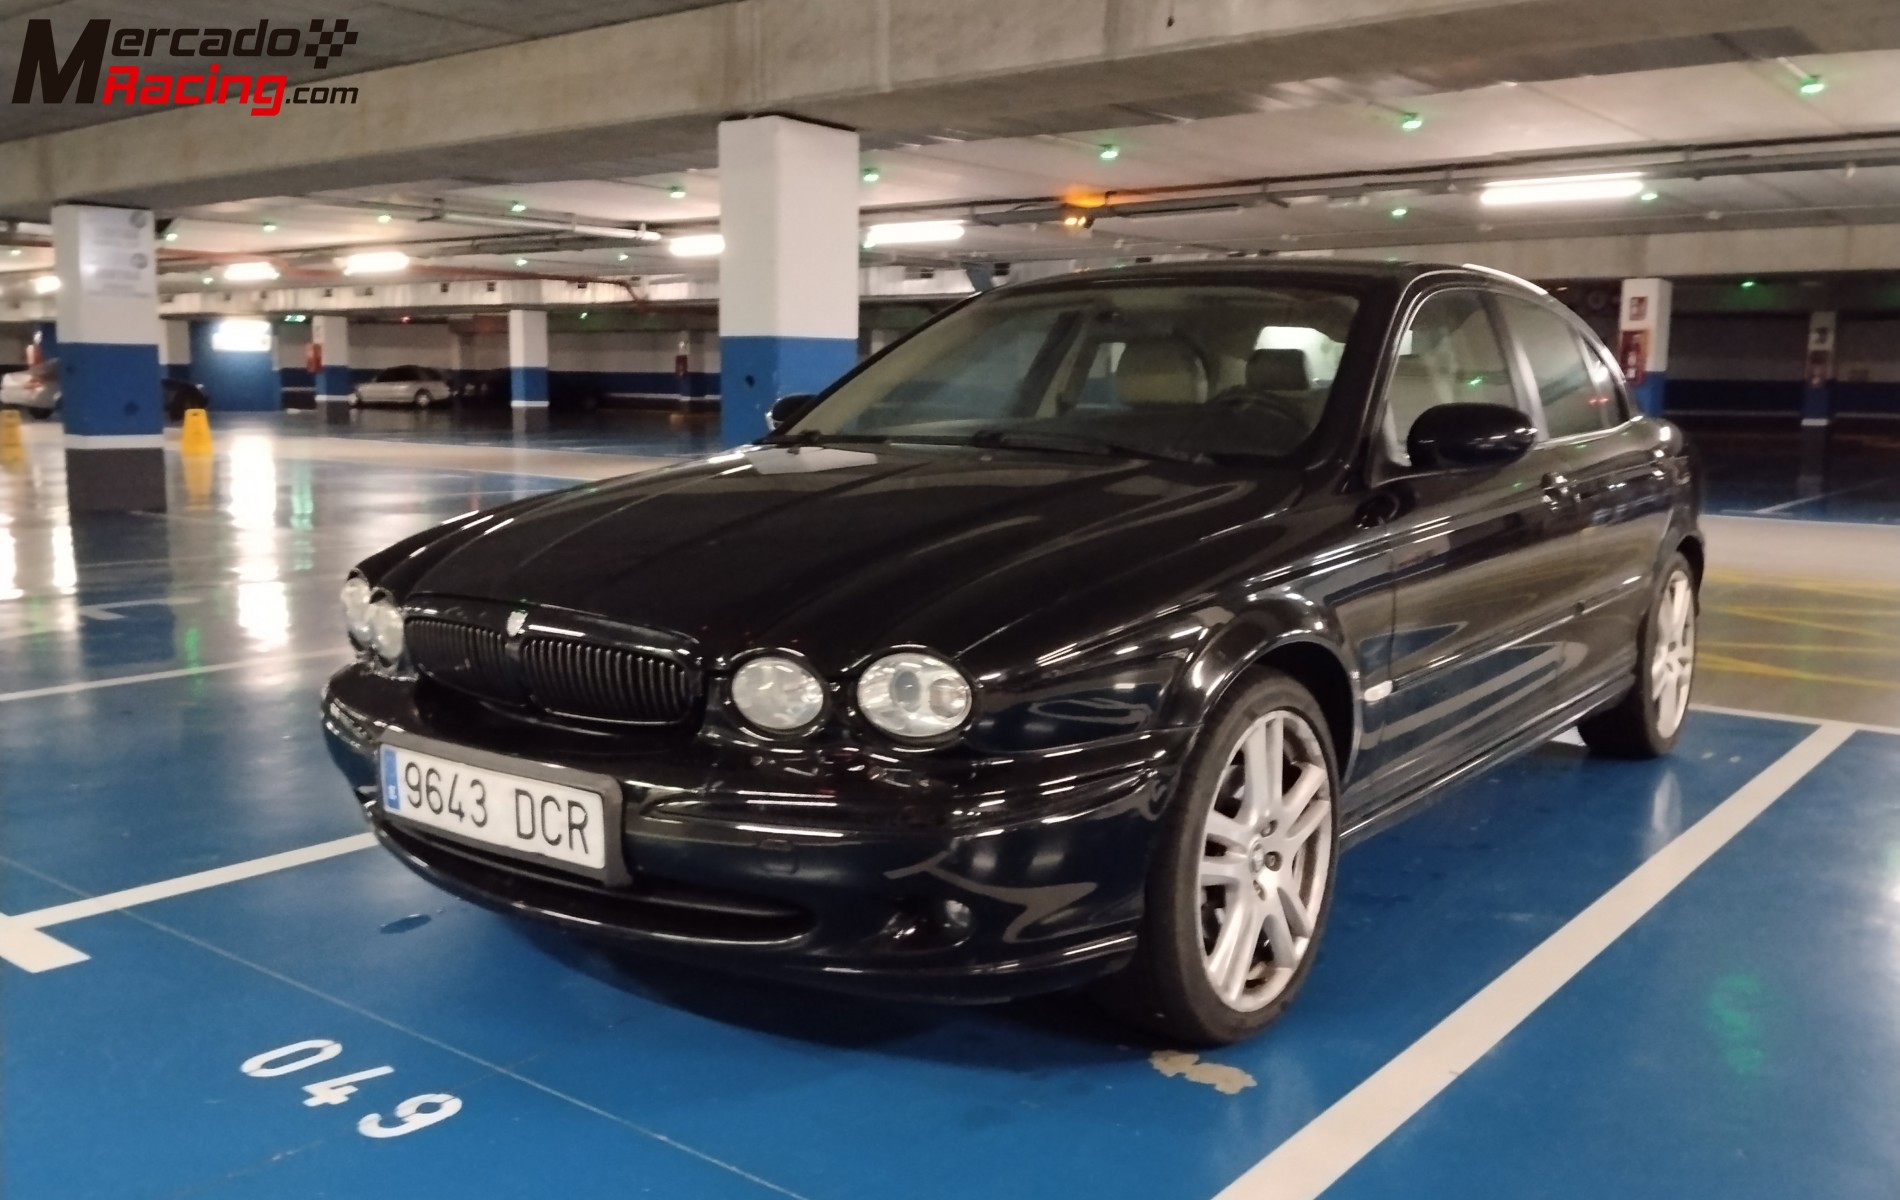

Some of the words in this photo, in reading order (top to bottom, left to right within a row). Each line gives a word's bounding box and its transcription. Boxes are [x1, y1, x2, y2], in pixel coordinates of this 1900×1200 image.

[405, 762, 488, 828] 9643
[515, 788, 590, 854] DCR
[240, 1039, 463, 1138] 049
